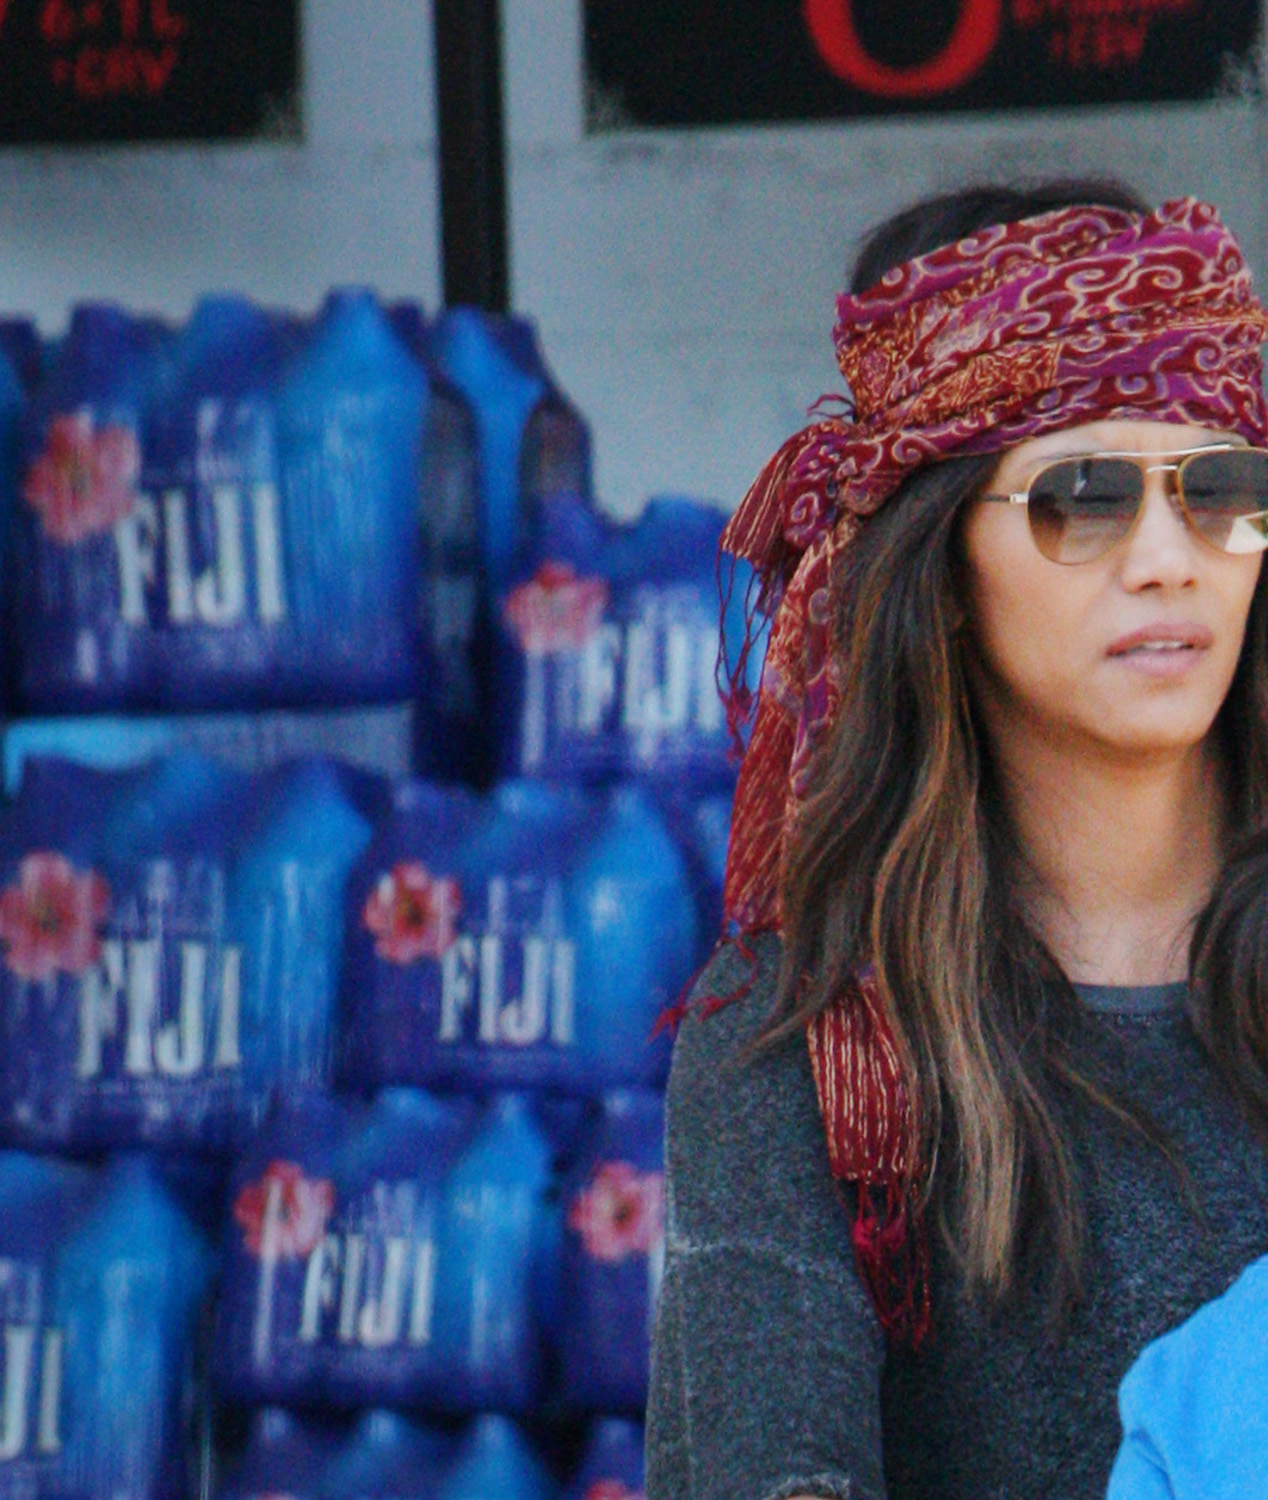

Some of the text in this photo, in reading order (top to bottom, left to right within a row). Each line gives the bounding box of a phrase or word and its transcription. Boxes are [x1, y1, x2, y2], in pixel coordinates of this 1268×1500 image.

[116, 482, 286, 626] FIJI
[77, 939, 242, 1078] FIJI
[440, 935, 575, 1044] FIJI
[300, 1233, 436, 1347] FIJI
